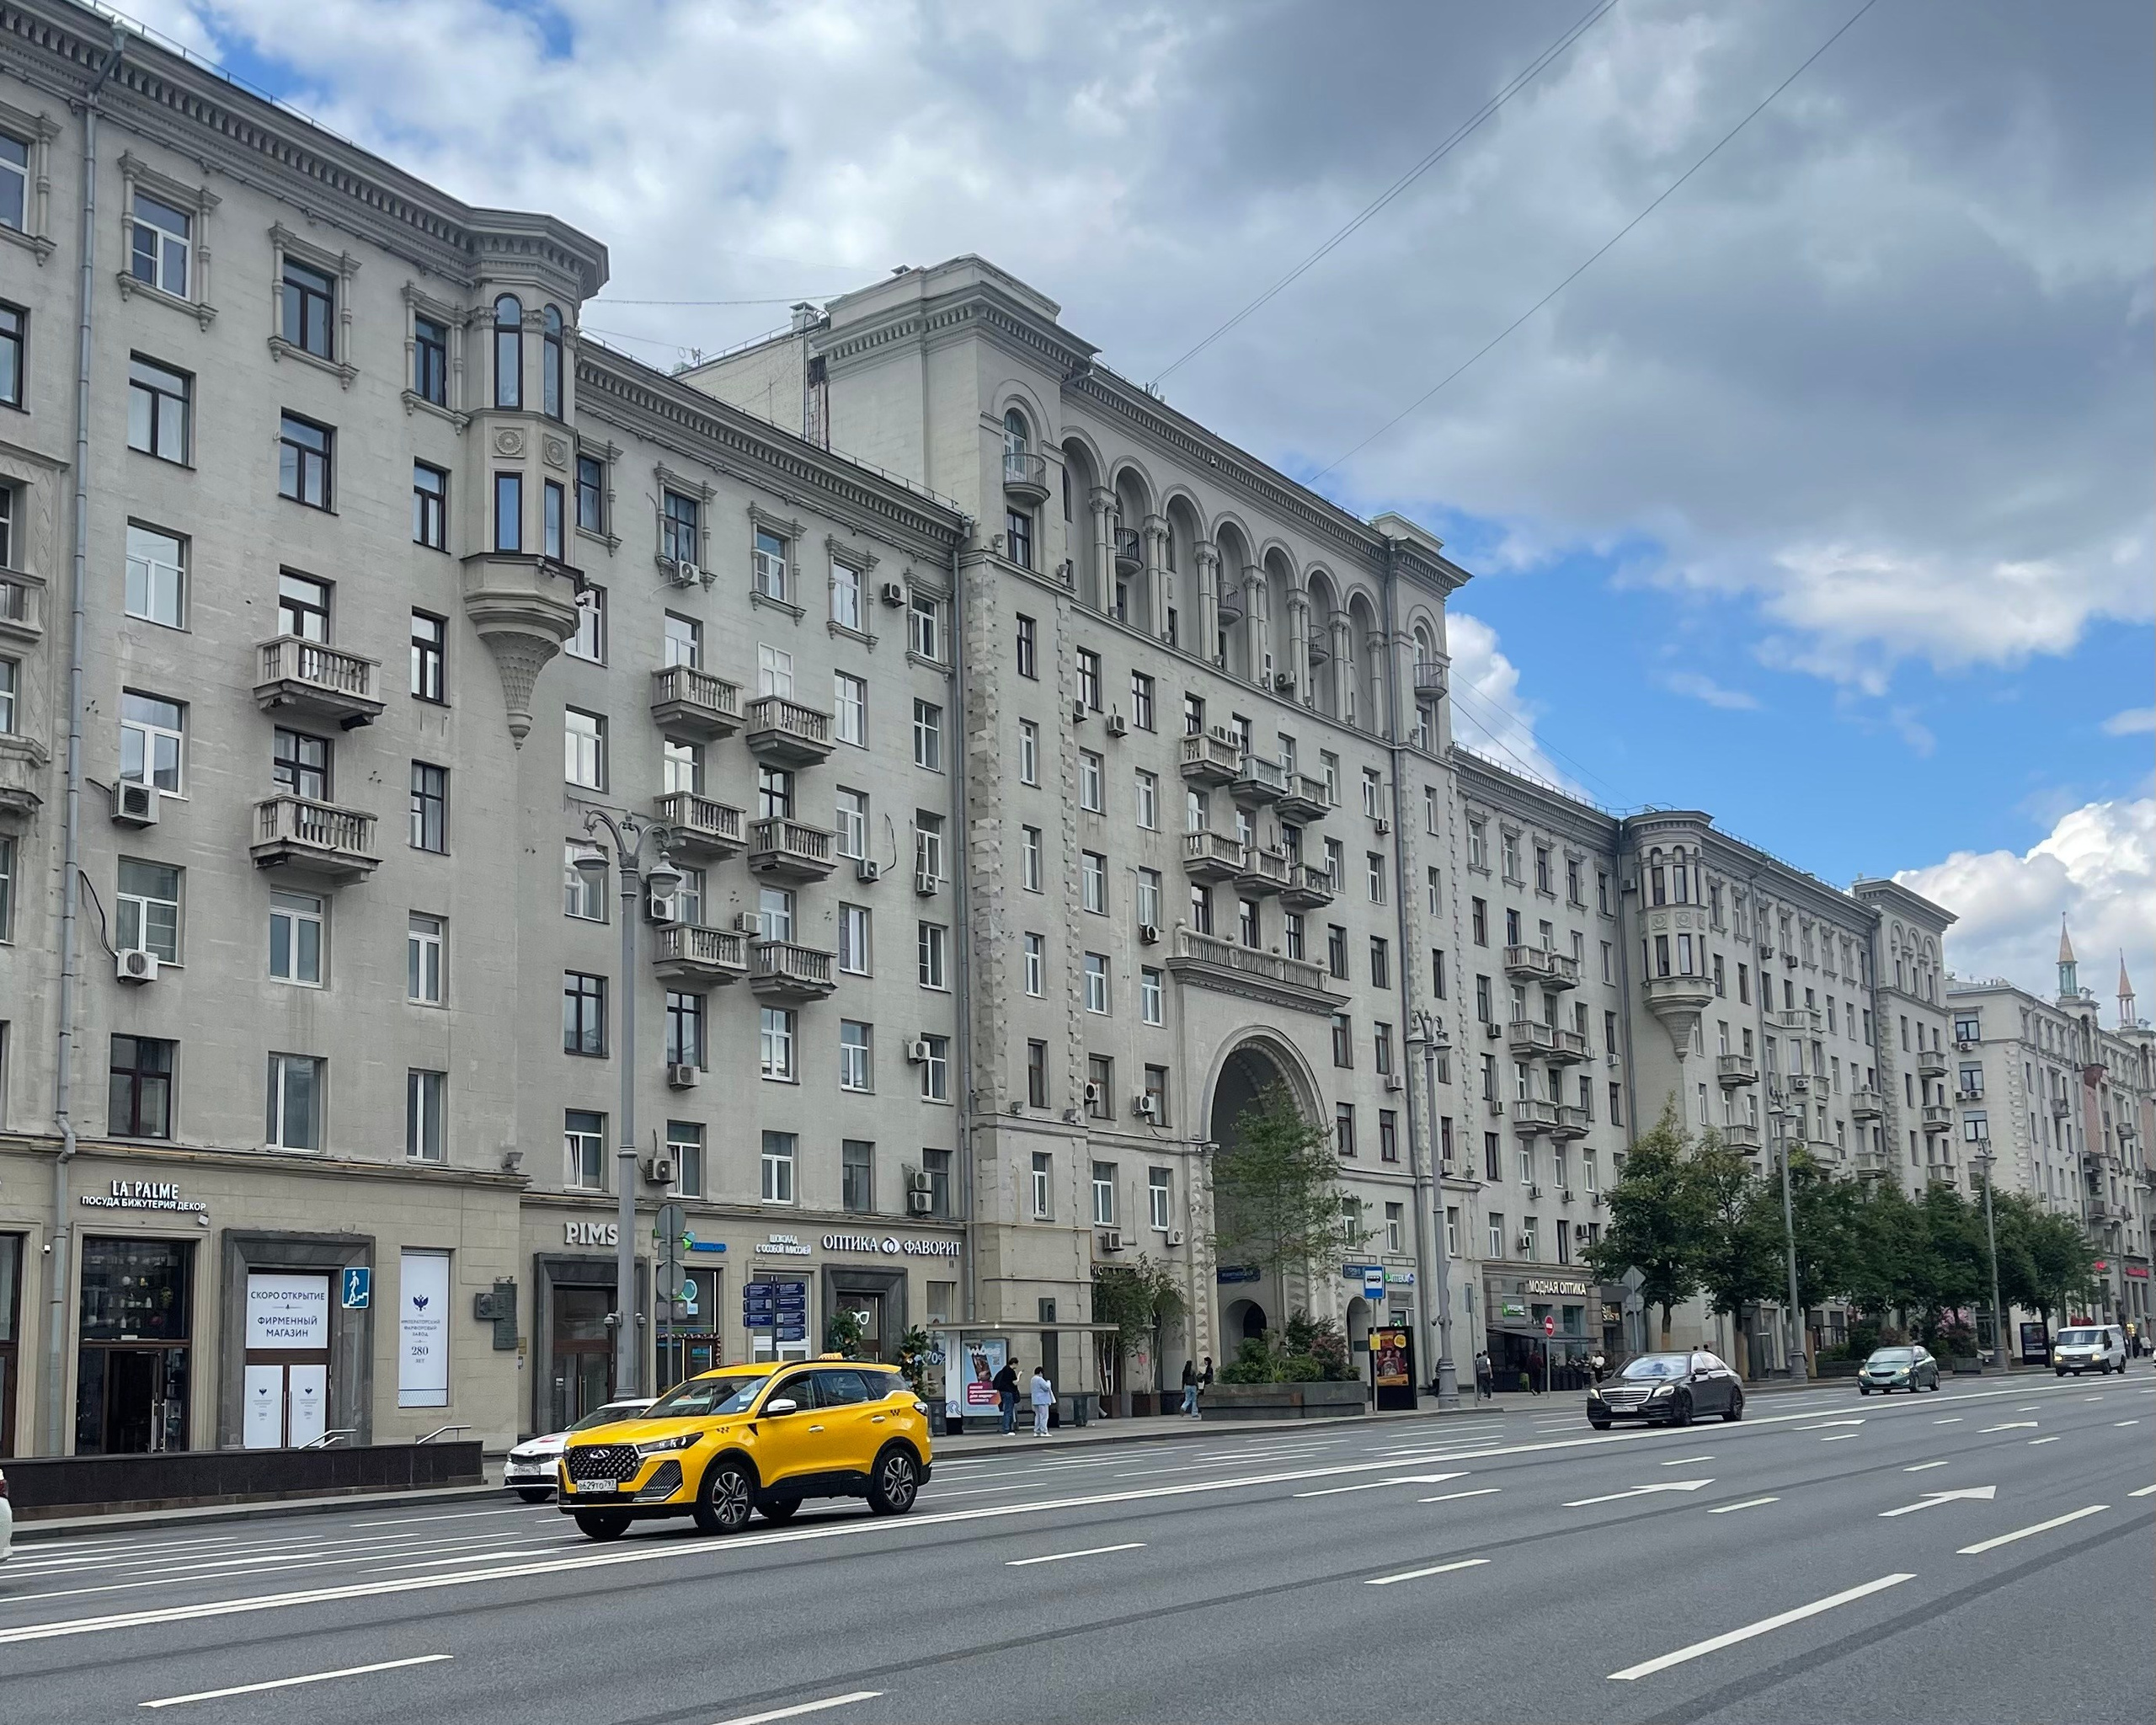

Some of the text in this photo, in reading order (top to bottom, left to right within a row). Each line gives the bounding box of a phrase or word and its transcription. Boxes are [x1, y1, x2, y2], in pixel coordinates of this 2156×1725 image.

[111, 1179, 179, 1199] LA PALME
[82, 1196, 206, 1211] ПОСУДА БИЖУТЕРИЯ ДЕКОР
[565, 1221, 619, 1246] PIMS
[823, 1234, 962, 1256] ОПТИКА ФАВОРИТ
[1529, 1279, 1587, 1295] МОДНАЯ ОПТИКА
[250, 1291, 325, 1300] СКОРО ОТКРЫТИЕ
[257, 1315, 318, 1325] ФИРМЕННЫЙ
[265, 1328, 309, 1338] МАГАЗИН
[411, 1346, 429, 1356] 280
